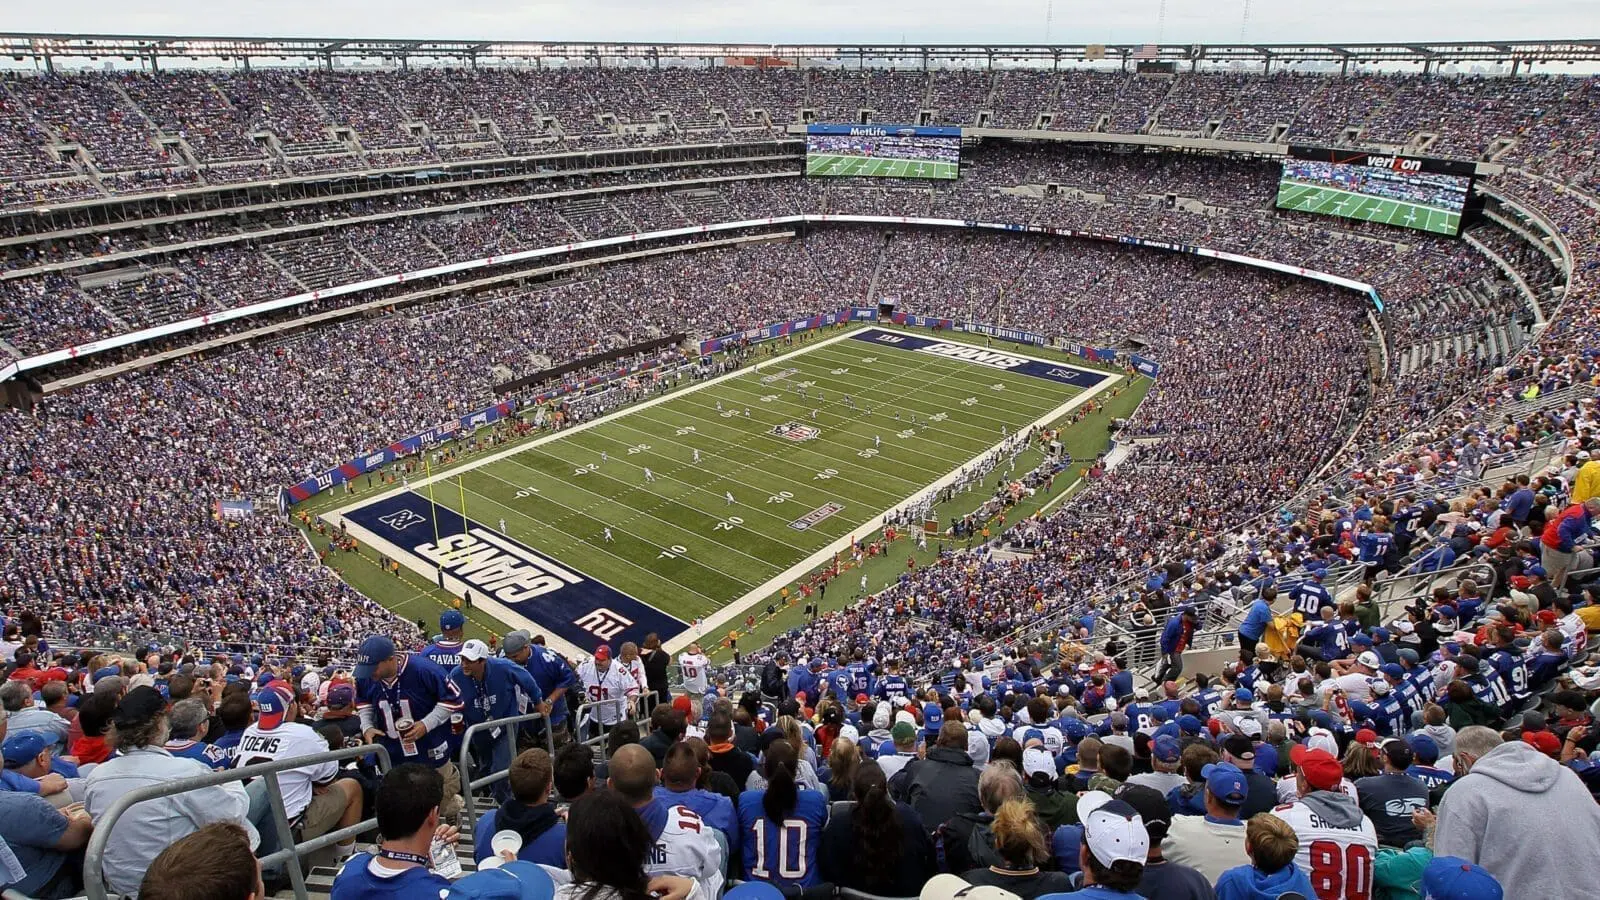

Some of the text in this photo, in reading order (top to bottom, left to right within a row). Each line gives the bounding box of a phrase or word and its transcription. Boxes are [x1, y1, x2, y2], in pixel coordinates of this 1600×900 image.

[850, 127, 887, 136] MetLife
[1367, 155, 1422, 171] verizon
[964, 323, 977, 332] NW
[1024, 332, 1044, 345] GIANTS
[914, 343, 1030, 369] GIANTS
[419, 431, 434, 444] ny
[857, 448, 880, 459] 50
[575, 463, 600, 475] 20
[816, 468, 839, 480] 40
[315, 473, 333, 490] ny
[516, 486, 540, 499] 10
[768, 490, 794, 503] 30
[717, 516, 744, 531] 20
[661, 545, 687, 559] 10
[414, 528, 585, 603] GIANTS
[1297, 593, 1319, 614] 10
[430, 654, 462, 665] BAVAR
[682, 666, 698, 679] 10
[588, 685, 609, 702] 91
[260, 703, 273, 713] ny
[240, 735, 282, 754] TOEWS
[1418, 774, 1448, 788] TAV
[677, 806, 701, 834] 10
[752, 818, 808, 878] 10
[1309, 840, 1372, 900] 80
